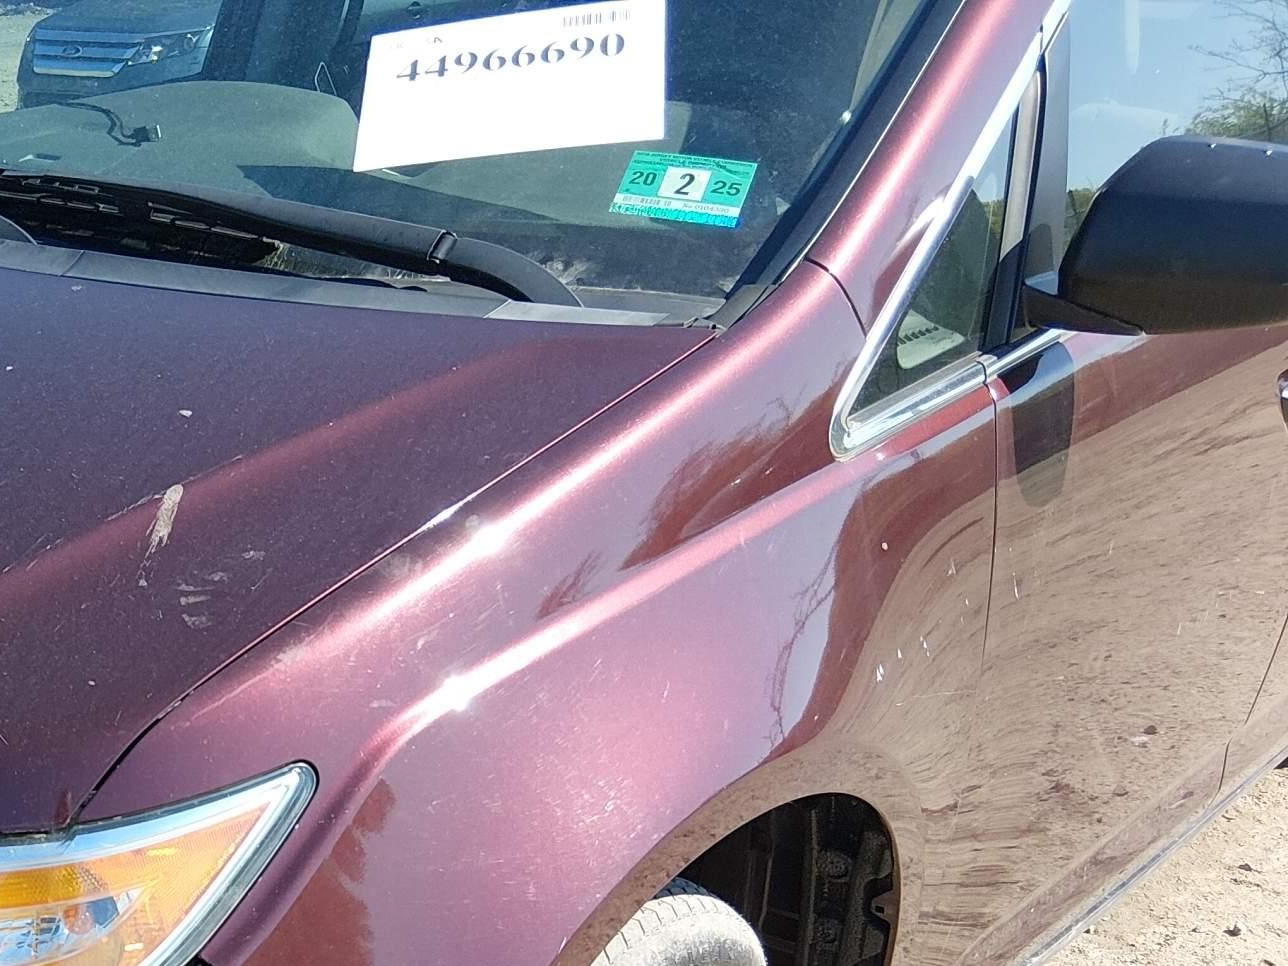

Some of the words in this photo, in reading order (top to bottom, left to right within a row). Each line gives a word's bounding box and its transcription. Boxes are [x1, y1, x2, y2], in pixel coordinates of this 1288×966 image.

[396, 33, 625, 81] 44966690
[628, 171, 658, 187] 20
[673, 173, 696, 196] 2
[711, 180, 743, 197] 25
